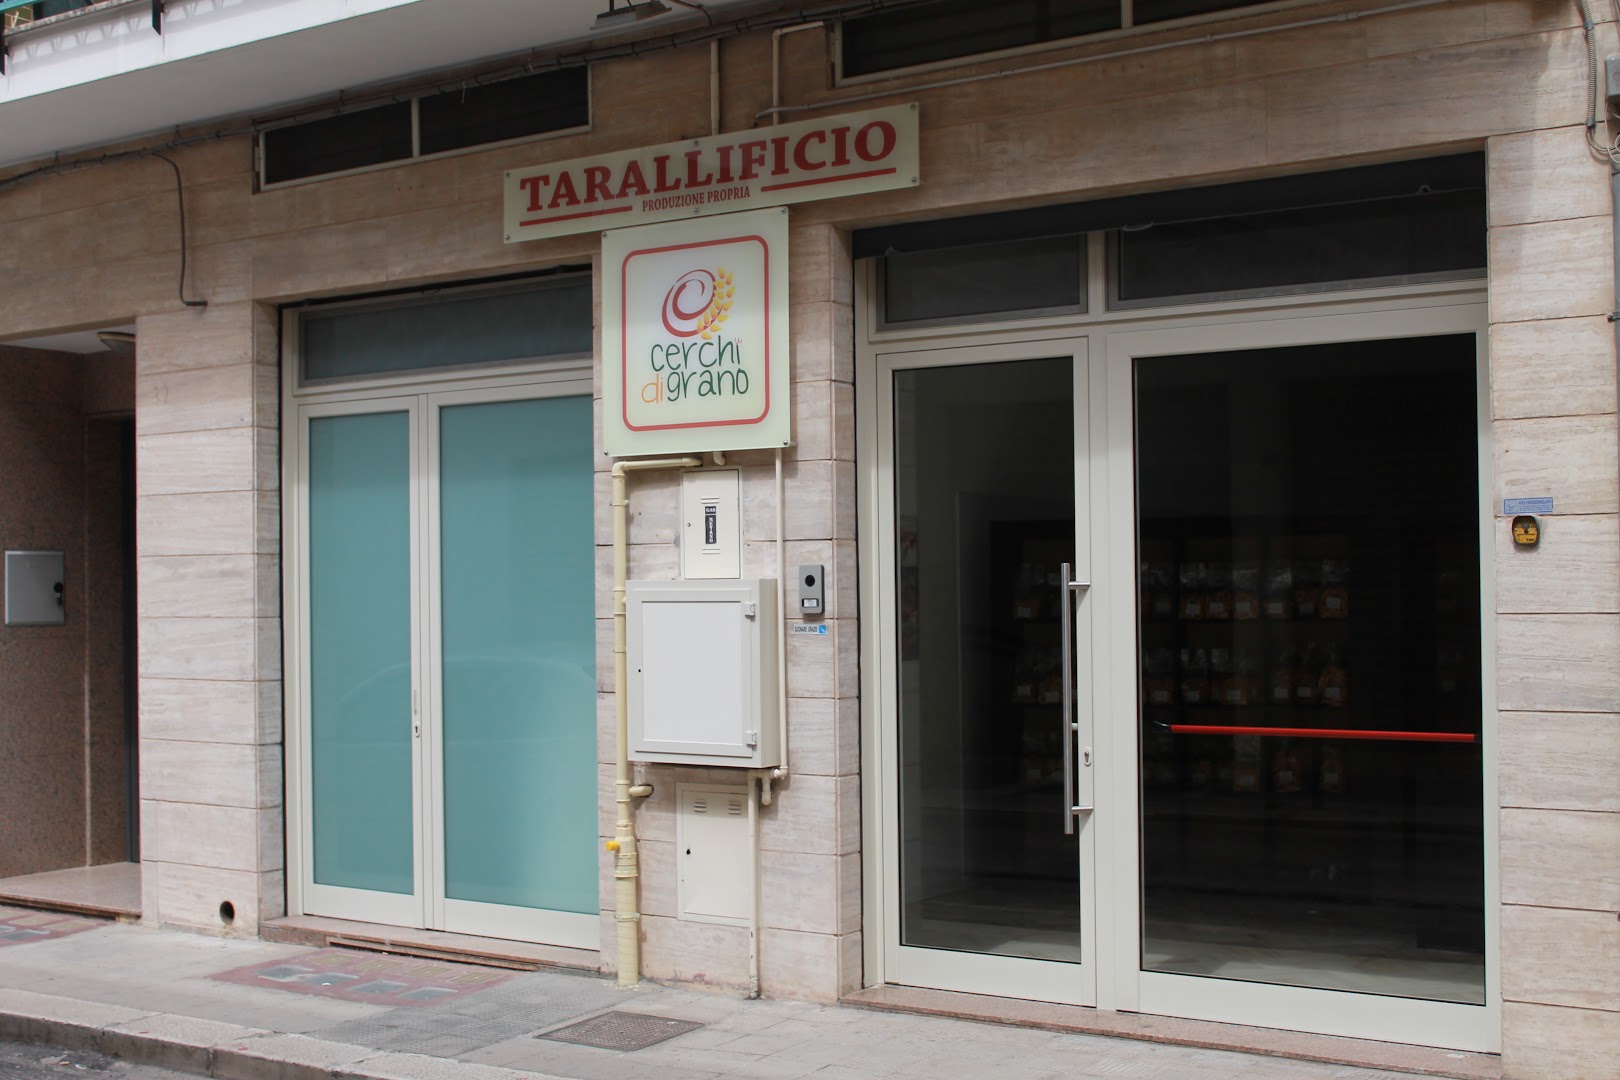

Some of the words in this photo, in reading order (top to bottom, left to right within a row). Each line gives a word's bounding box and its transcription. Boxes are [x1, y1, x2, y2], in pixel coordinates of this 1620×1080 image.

[519, 120, 897, 212] TARALLIFICIO
[642, 192, 705, 212] PRODUZIONE
[707, 185, 751, 203] PROPRIA
[651, 335, 742, 372] cerchi
[641, 373, 664, 404] di
[667, 368, 749, 402] grano
